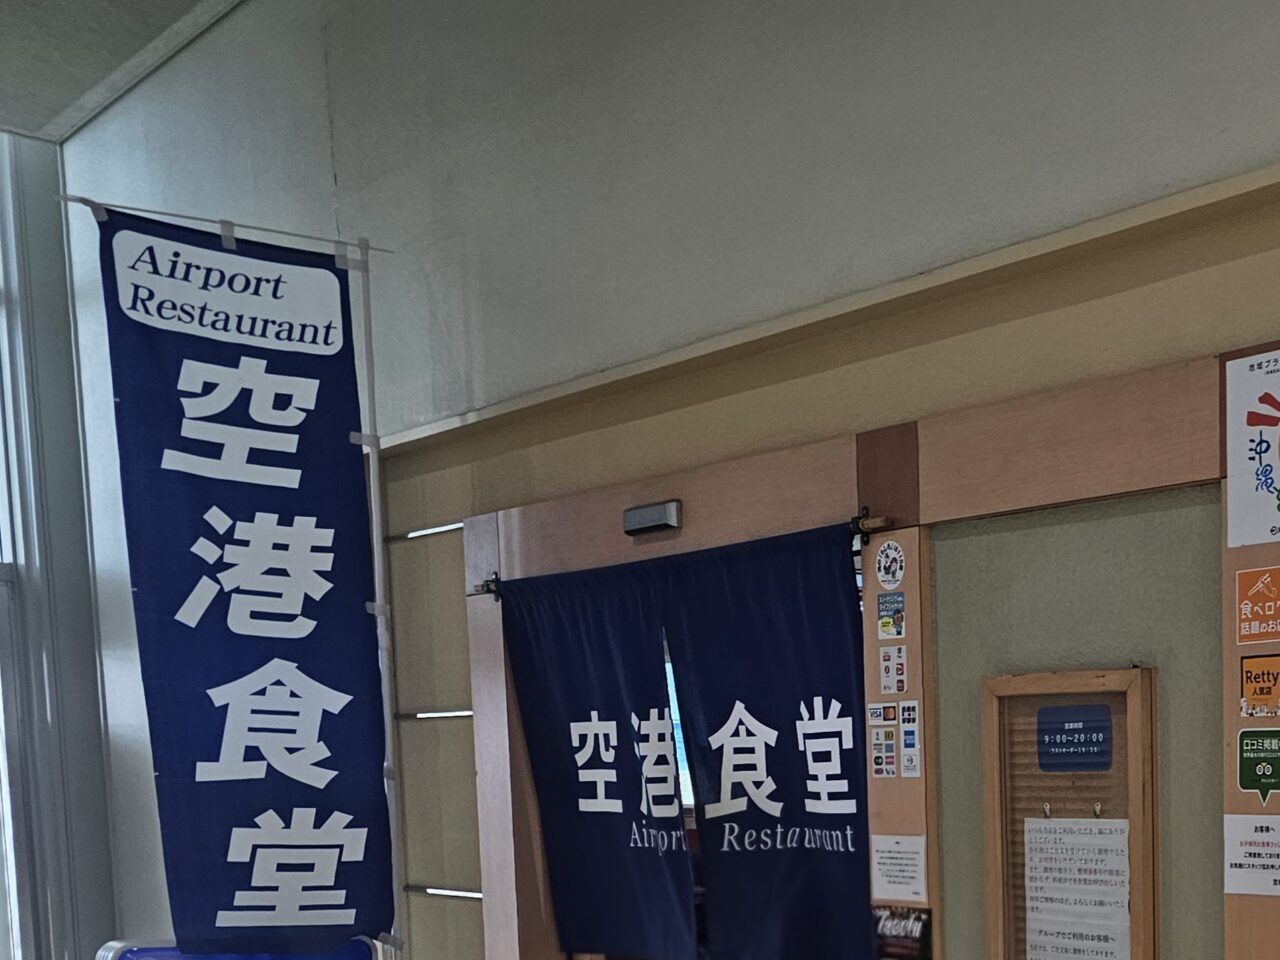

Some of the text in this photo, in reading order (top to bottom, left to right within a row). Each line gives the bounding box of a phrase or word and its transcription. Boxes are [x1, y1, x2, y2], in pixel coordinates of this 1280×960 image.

[128, 244, 287, 300] Airport
[126, 282, 338, 346] Restaurant
[161, 355, 368, 927] 空港食堂
[1245, 670, 1280, 687] Retty
[570, 697, 857, 818] 空港食堂
[630, 820, 856, 856] Airport Restaurant
